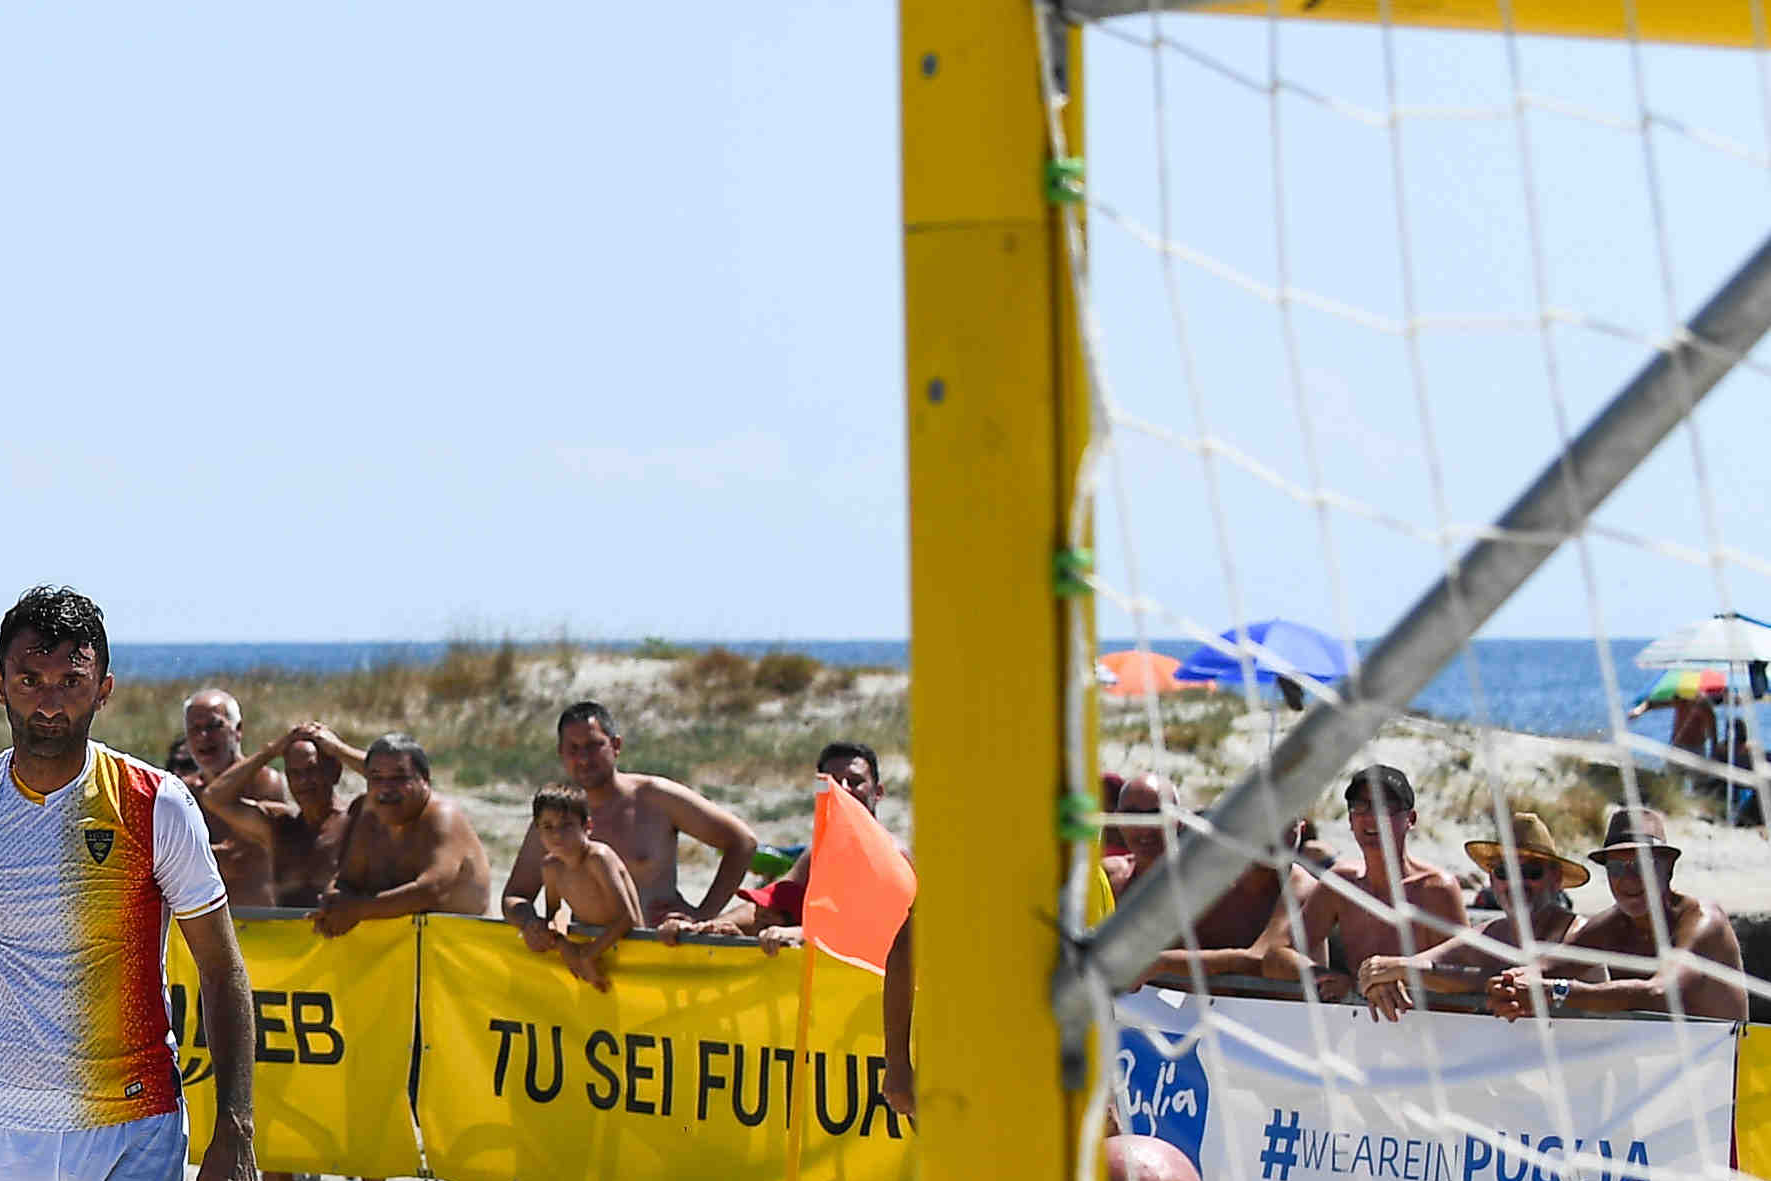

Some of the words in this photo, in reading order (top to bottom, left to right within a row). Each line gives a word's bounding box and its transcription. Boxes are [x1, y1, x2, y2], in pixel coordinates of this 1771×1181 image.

[489, 1018, 563, 1104] TU
[585, 1029, 673, 1117] SEI
[697, 1040, 917, 1139] FUTUR
